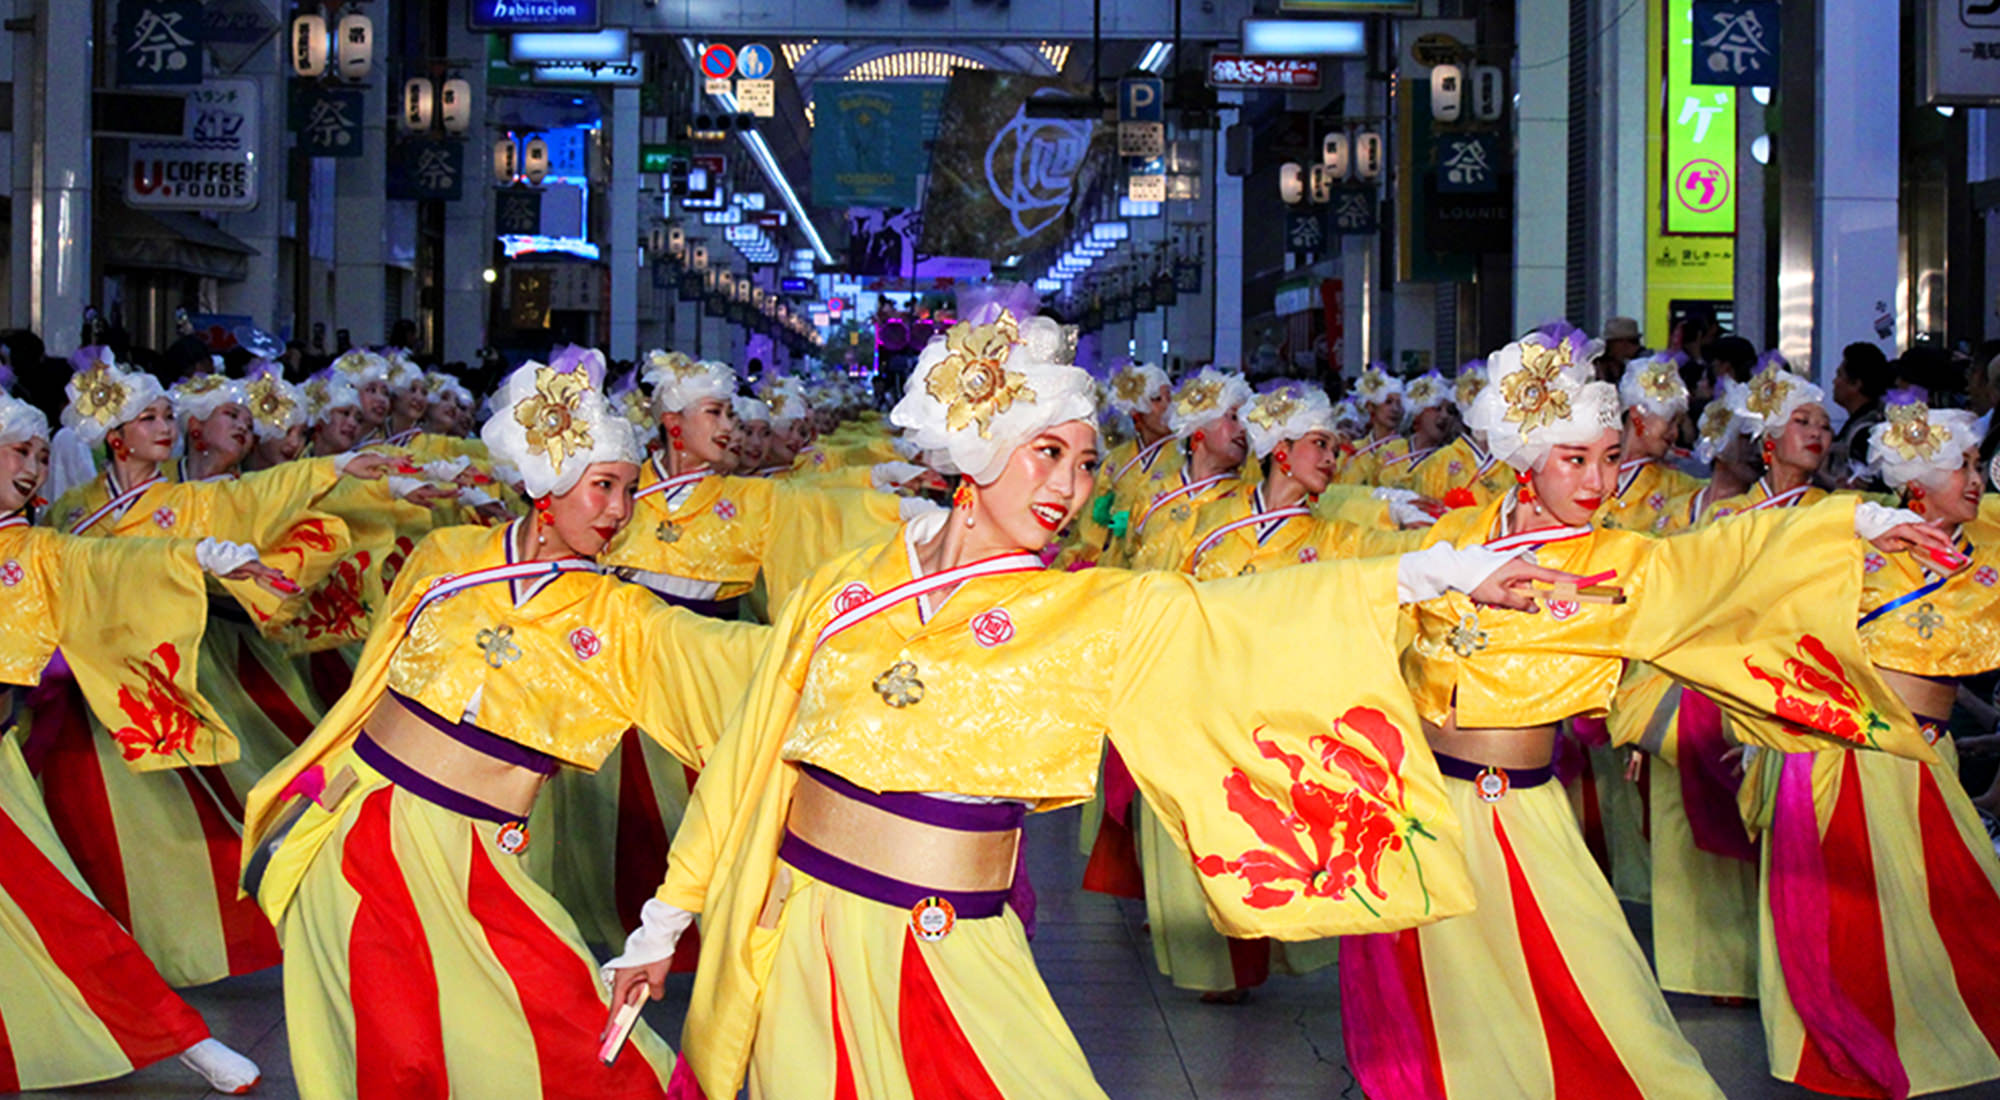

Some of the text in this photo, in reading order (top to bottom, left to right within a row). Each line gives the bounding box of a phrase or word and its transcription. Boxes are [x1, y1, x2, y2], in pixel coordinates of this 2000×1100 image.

[128, 9, 195, 72] 祭
[1129, 83, 1155, 118] P
[305, 98, 355, 147] 祭
[166, 161, 246, 182] COFFEE
[415, 149, 457, 188] 祭
[175, 183, 246, 197] FOODS
